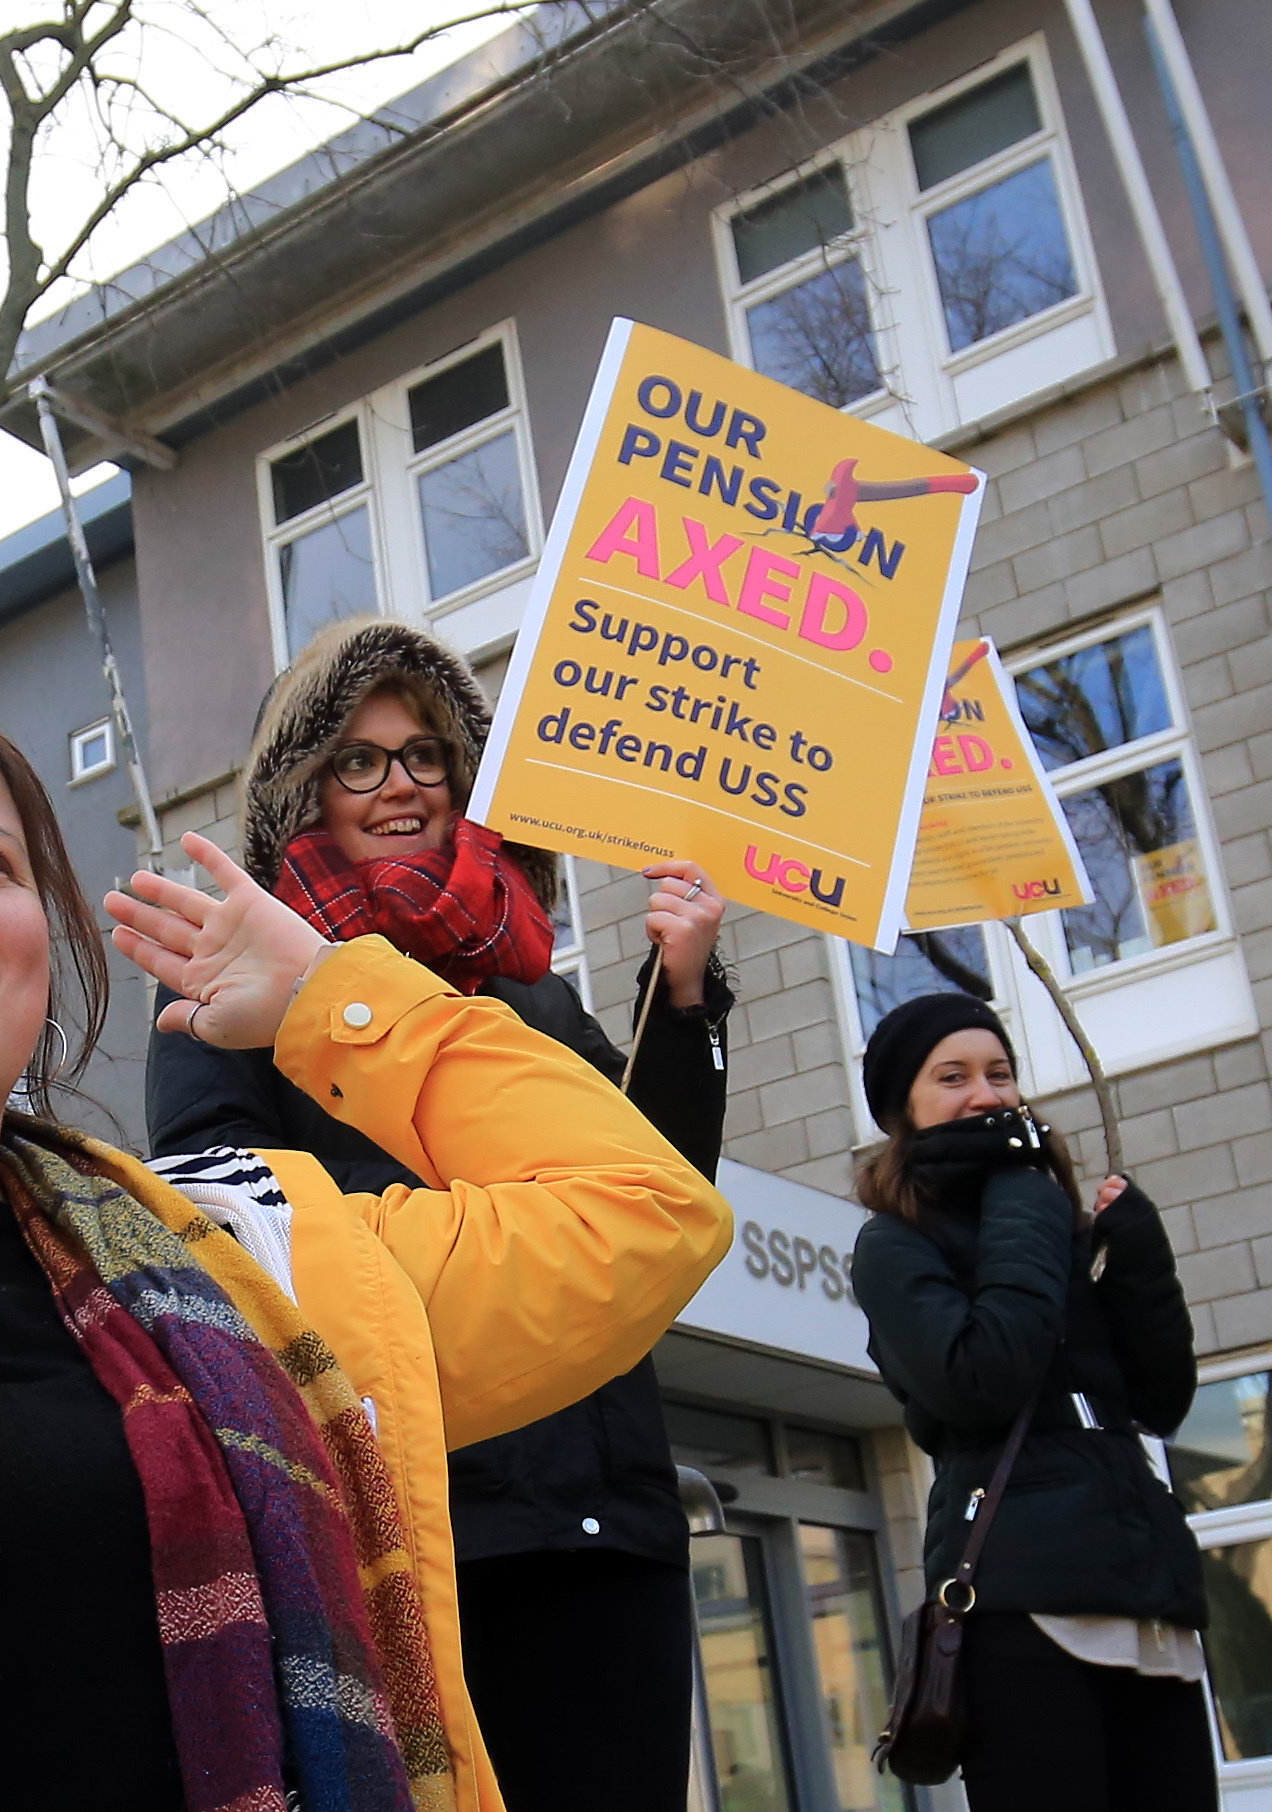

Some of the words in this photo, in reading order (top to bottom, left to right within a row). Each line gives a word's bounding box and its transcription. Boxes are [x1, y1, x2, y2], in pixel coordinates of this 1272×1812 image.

[635, 375, 766, 459] OUR
[617, 426, 905, 580] PENSION
[585, 496, 893, 674] AXED.
[568, 599, 761, 690] Support
[536, 707, 707, 781] defend
[719, 757, 809, 818] USS
[553, 661, 638, 702] our
[645, 677, 778, 753] strike
[790, 728, 834, 772] to
[928, 733, 1013, 776] ED.
[509, 812, 674, 858] www.ucu.org.uk/strikeforuss
